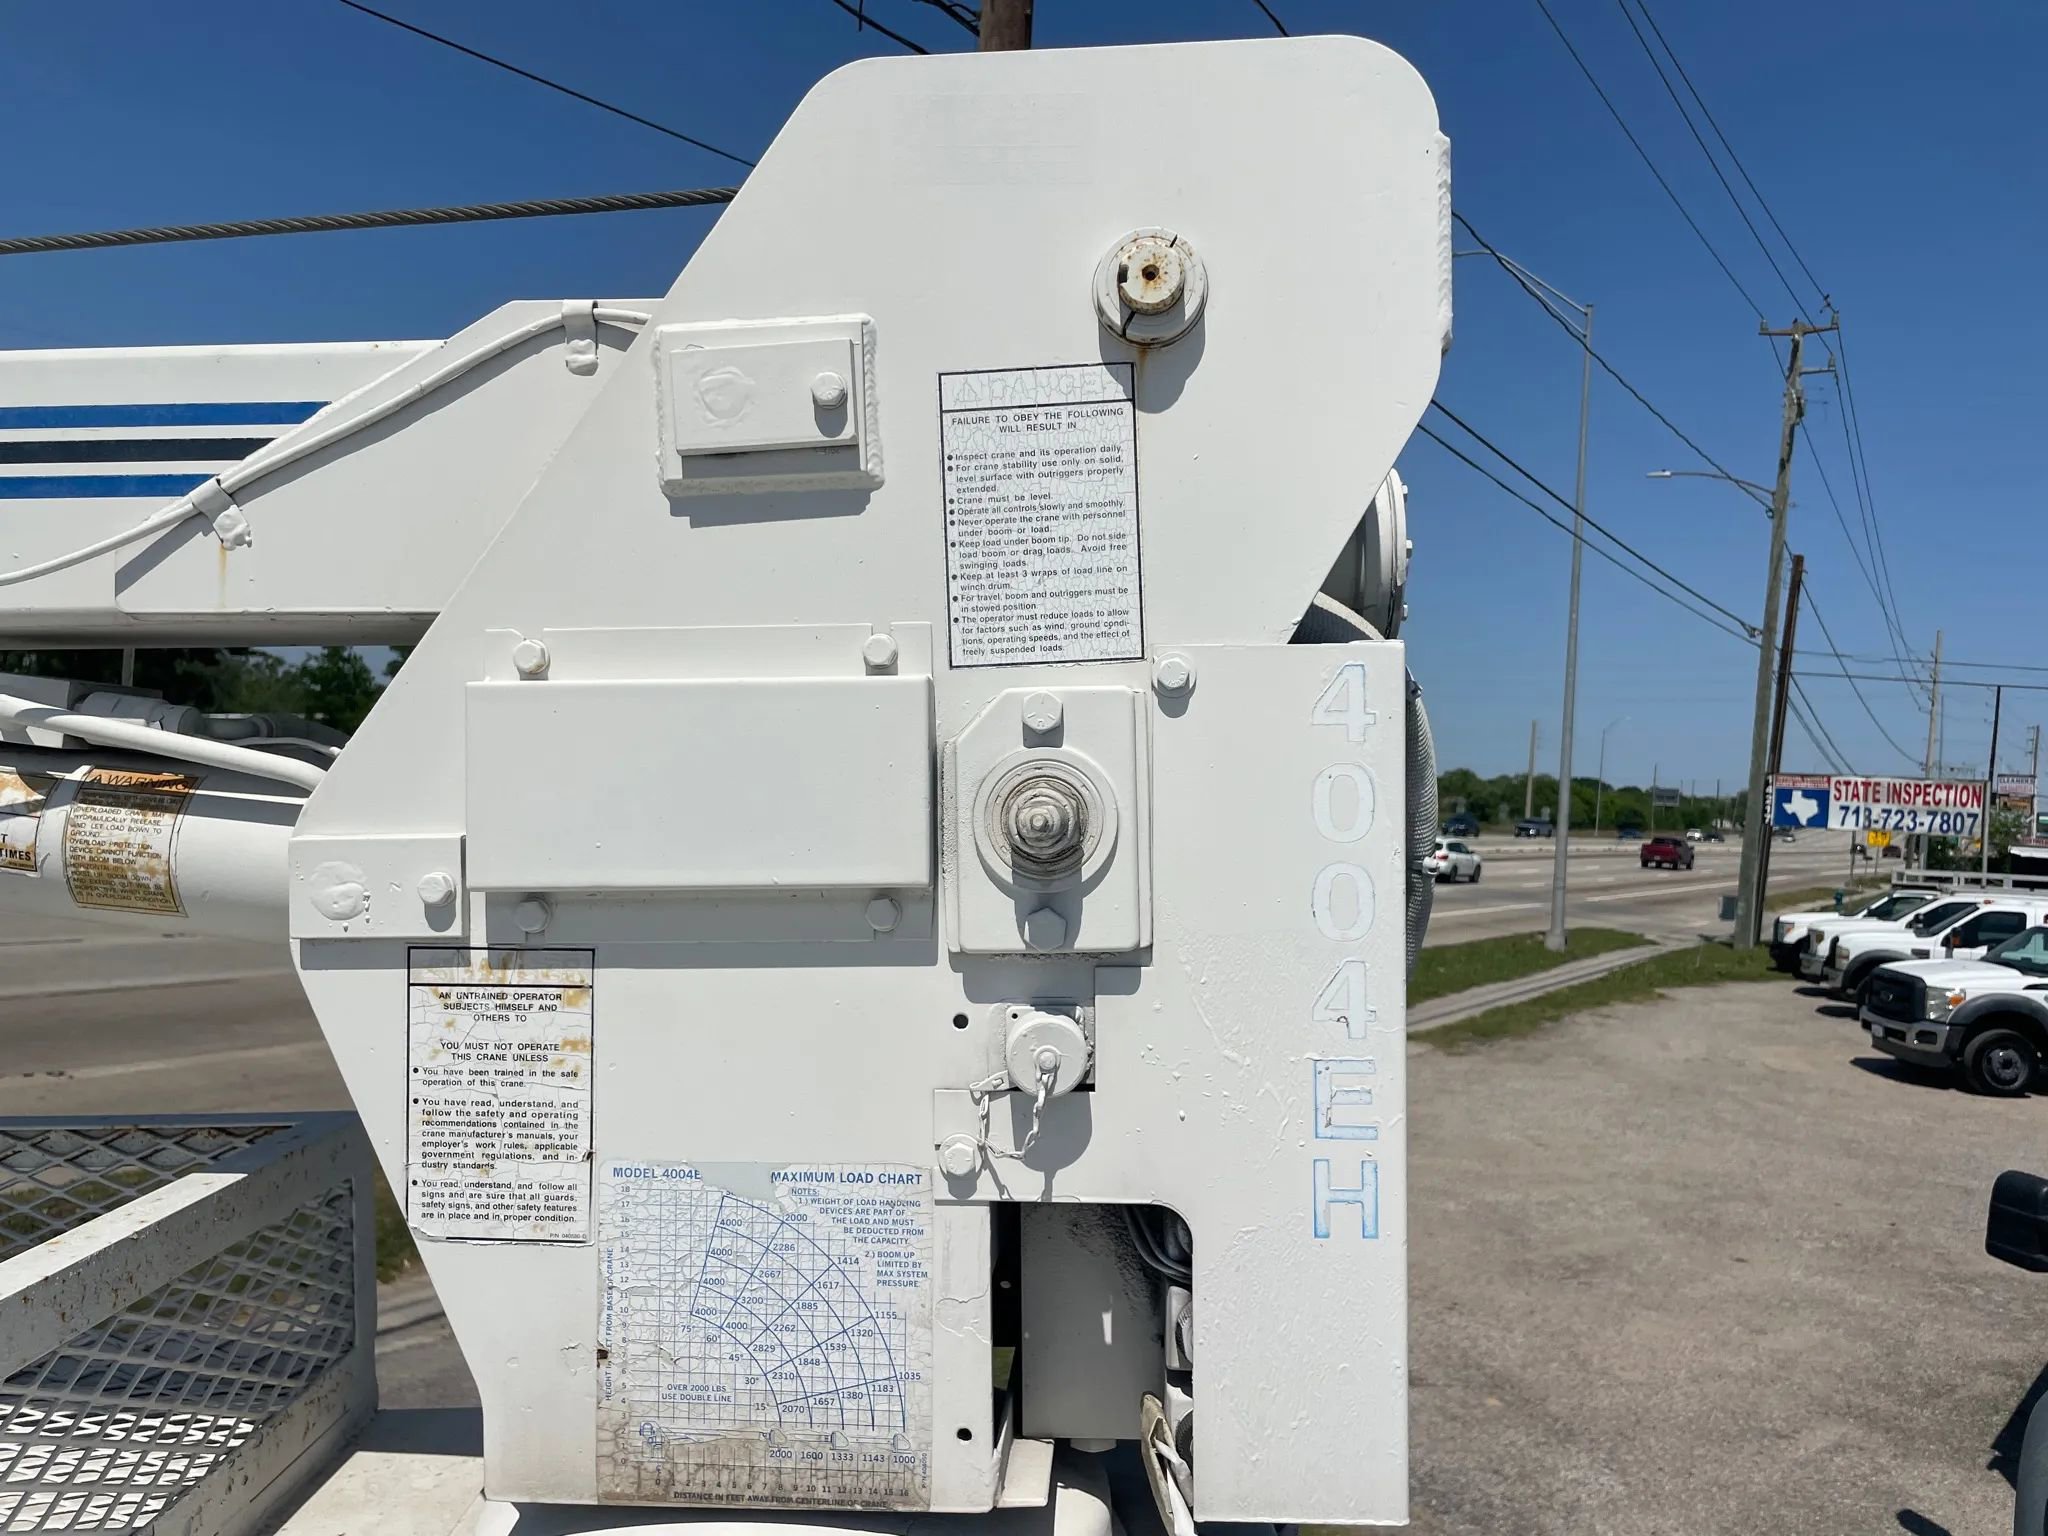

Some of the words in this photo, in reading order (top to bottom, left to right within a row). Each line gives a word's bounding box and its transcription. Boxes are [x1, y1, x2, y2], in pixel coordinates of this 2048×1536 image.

[952, 416, 989, 424] FAILURE
[1013, 413, 1038, 421] OBEY
[1044, 411, 1061, 419] THE
[1067, 408, 1123, 418] FOLLOWING
[1026, 422, 1061, 431] RESULT
[955, 452, 987, 462] Inspect
[1054, 446, 1096, 456] operation
[1100, 445, 1123, 454] daily.
[1003, 460, 1037, 470] stability
[1061, 458, 1079, 467] only
[980, 473, 1012, 481] surface
[1038, 469, 1082, 479] outriggers
[1087, 467, 1123, 477] properly
[956, 485, 997, 493] extended.
[957, 496, 982, 504] Crane
[106, 774, 189, 791] WARNING
[1834, 781, 1881, 802] STATE
[1887, 782, 1982, 808] INSPECTION
[613, 1168, 658, 1178] MODEL
[771, 1172, 834, 1183] MAXIMUM
[840, 1173, 873, 1183] LOAD
[879, 1174, 922, 1184] CHART
[792, 1188, 820, 1196] NOTES:
[785, 1214, 808, 1222] 2000
[857, 1227, 899, 1235] DEDUCTED
[710, 1248, 732, 1256] 4000
[703, 1278, 725, 1286] 4000
[740, 1296, 764, 1304] 3200
[796, 1302, 818, 1310] 1885
[694, 1308, 717, 1316] 4000
[725, 1322, 748, 1330] 4000
[774, 1324, 796, 1332] 2262
[753, 1344, 776, 1352] 2829
[824, 1343, 846, 1351] 1539
[799, 1358, 820, 1366] 1848
[772, 1372, 794, 1380] 2310
[899, 1372, 920, 1380] 1035
[680, 1394, 711, 1402] DOUBLE
[714, 1395, 732, 1403] LINE
[813, 1398, 834, 1406] 1657
[782, 1405, 804, 1413] 2070
[770, 1451, 792, 1459] 2000
[801, 1452, 823, 1460] 1600
[832, 1453, 853, 1461] 1333
[863, 1454, 885, 1462] 1143
[894, 1455, 915, 1463] 1000
